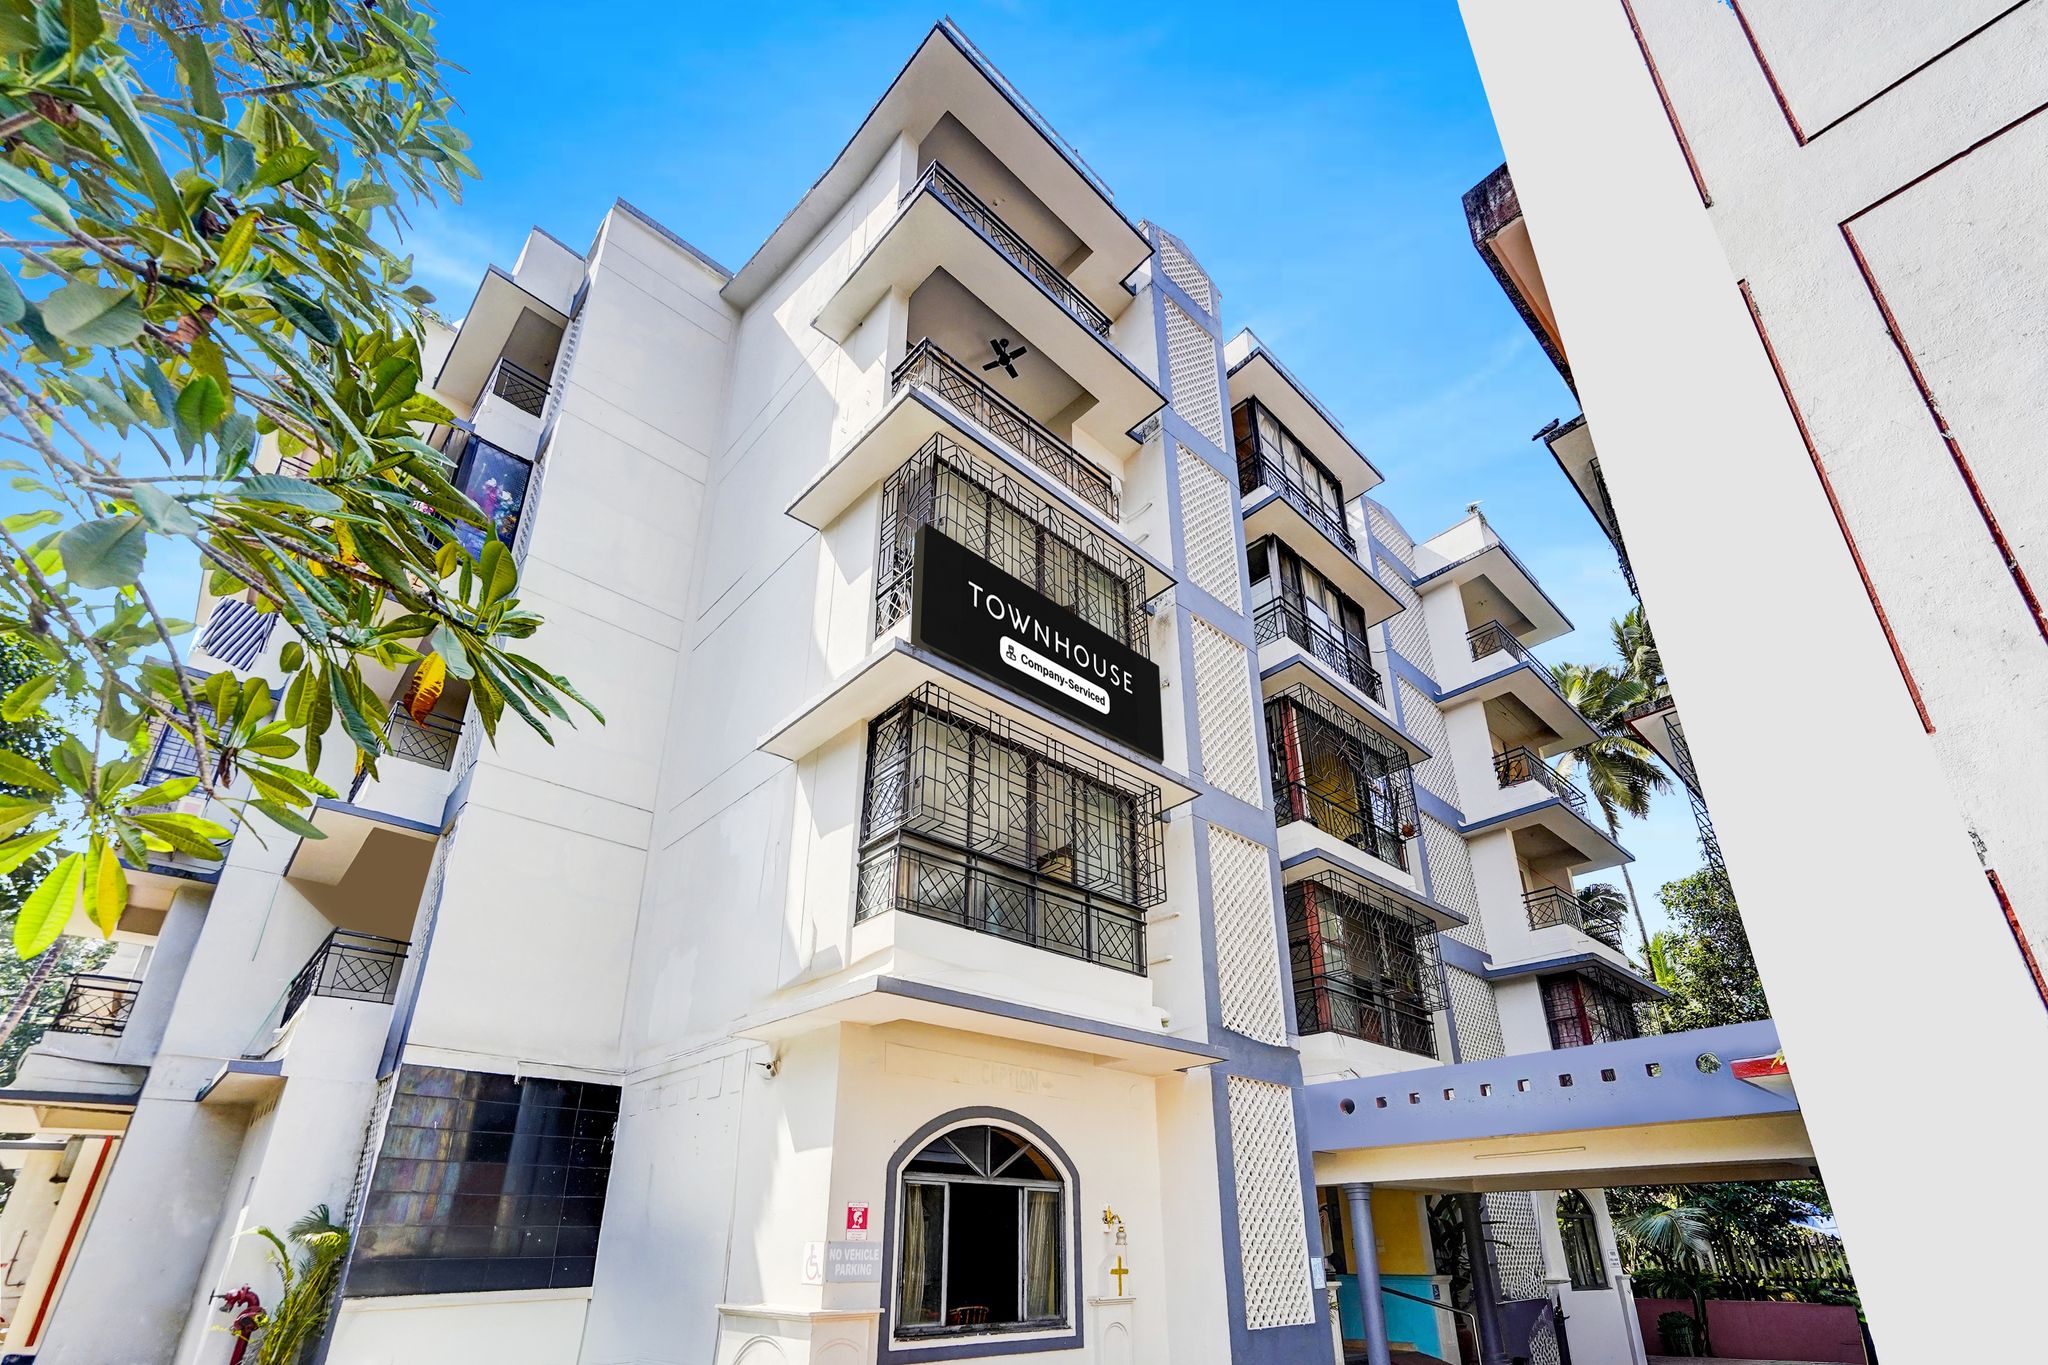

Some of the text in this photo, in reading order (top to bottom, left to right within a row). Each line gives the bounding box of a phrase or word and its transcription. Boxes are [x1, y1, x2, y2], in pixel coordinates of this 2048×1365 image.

[968, 580, 1133, 694] TOWNHOUSE
[1021, 653, 1105, 706] Company-Serviced
[829, 1248, 880, 1260] NO VEHICLE
[834, 1263, 873, 1276] PARKING
